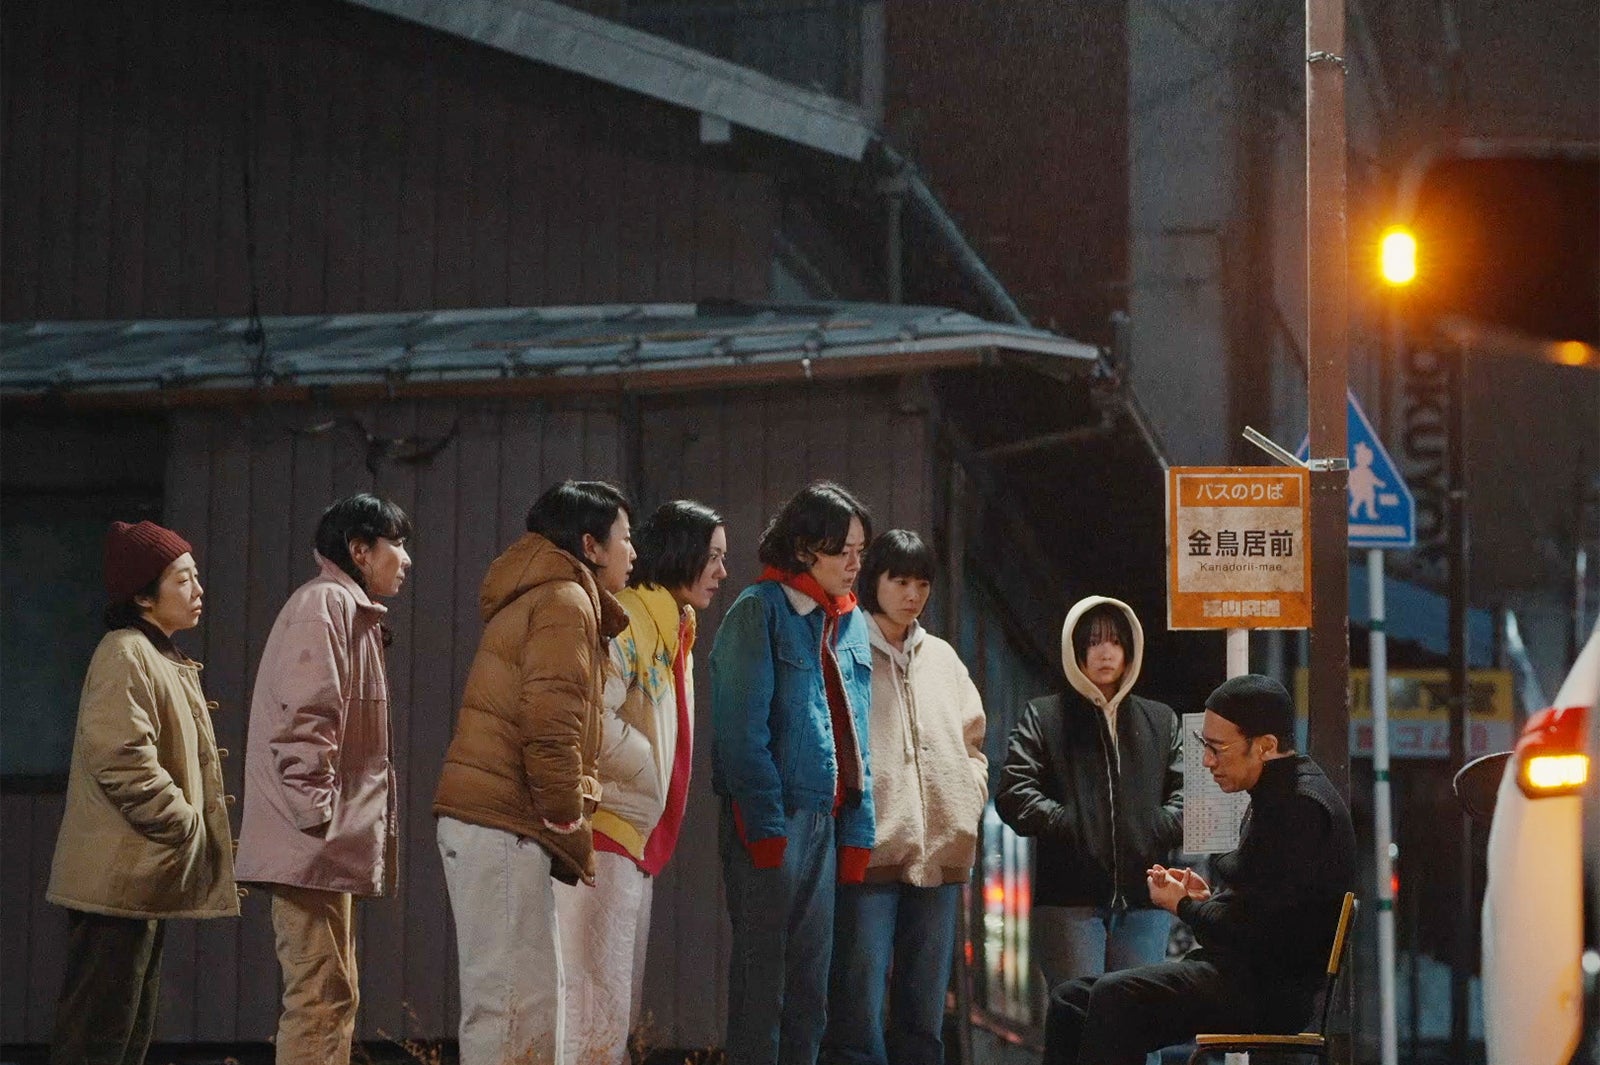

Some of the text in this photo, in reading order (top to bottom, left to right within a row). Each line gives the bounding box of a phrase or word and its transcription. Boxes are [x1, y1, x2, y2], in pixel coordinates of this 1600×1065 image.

[1196, 483, 1284, 500] バスのりば
[1187, 529, 1294, 557] 金鳥居前
[1200, 562, 1282, 572] Kanadorii-mae
